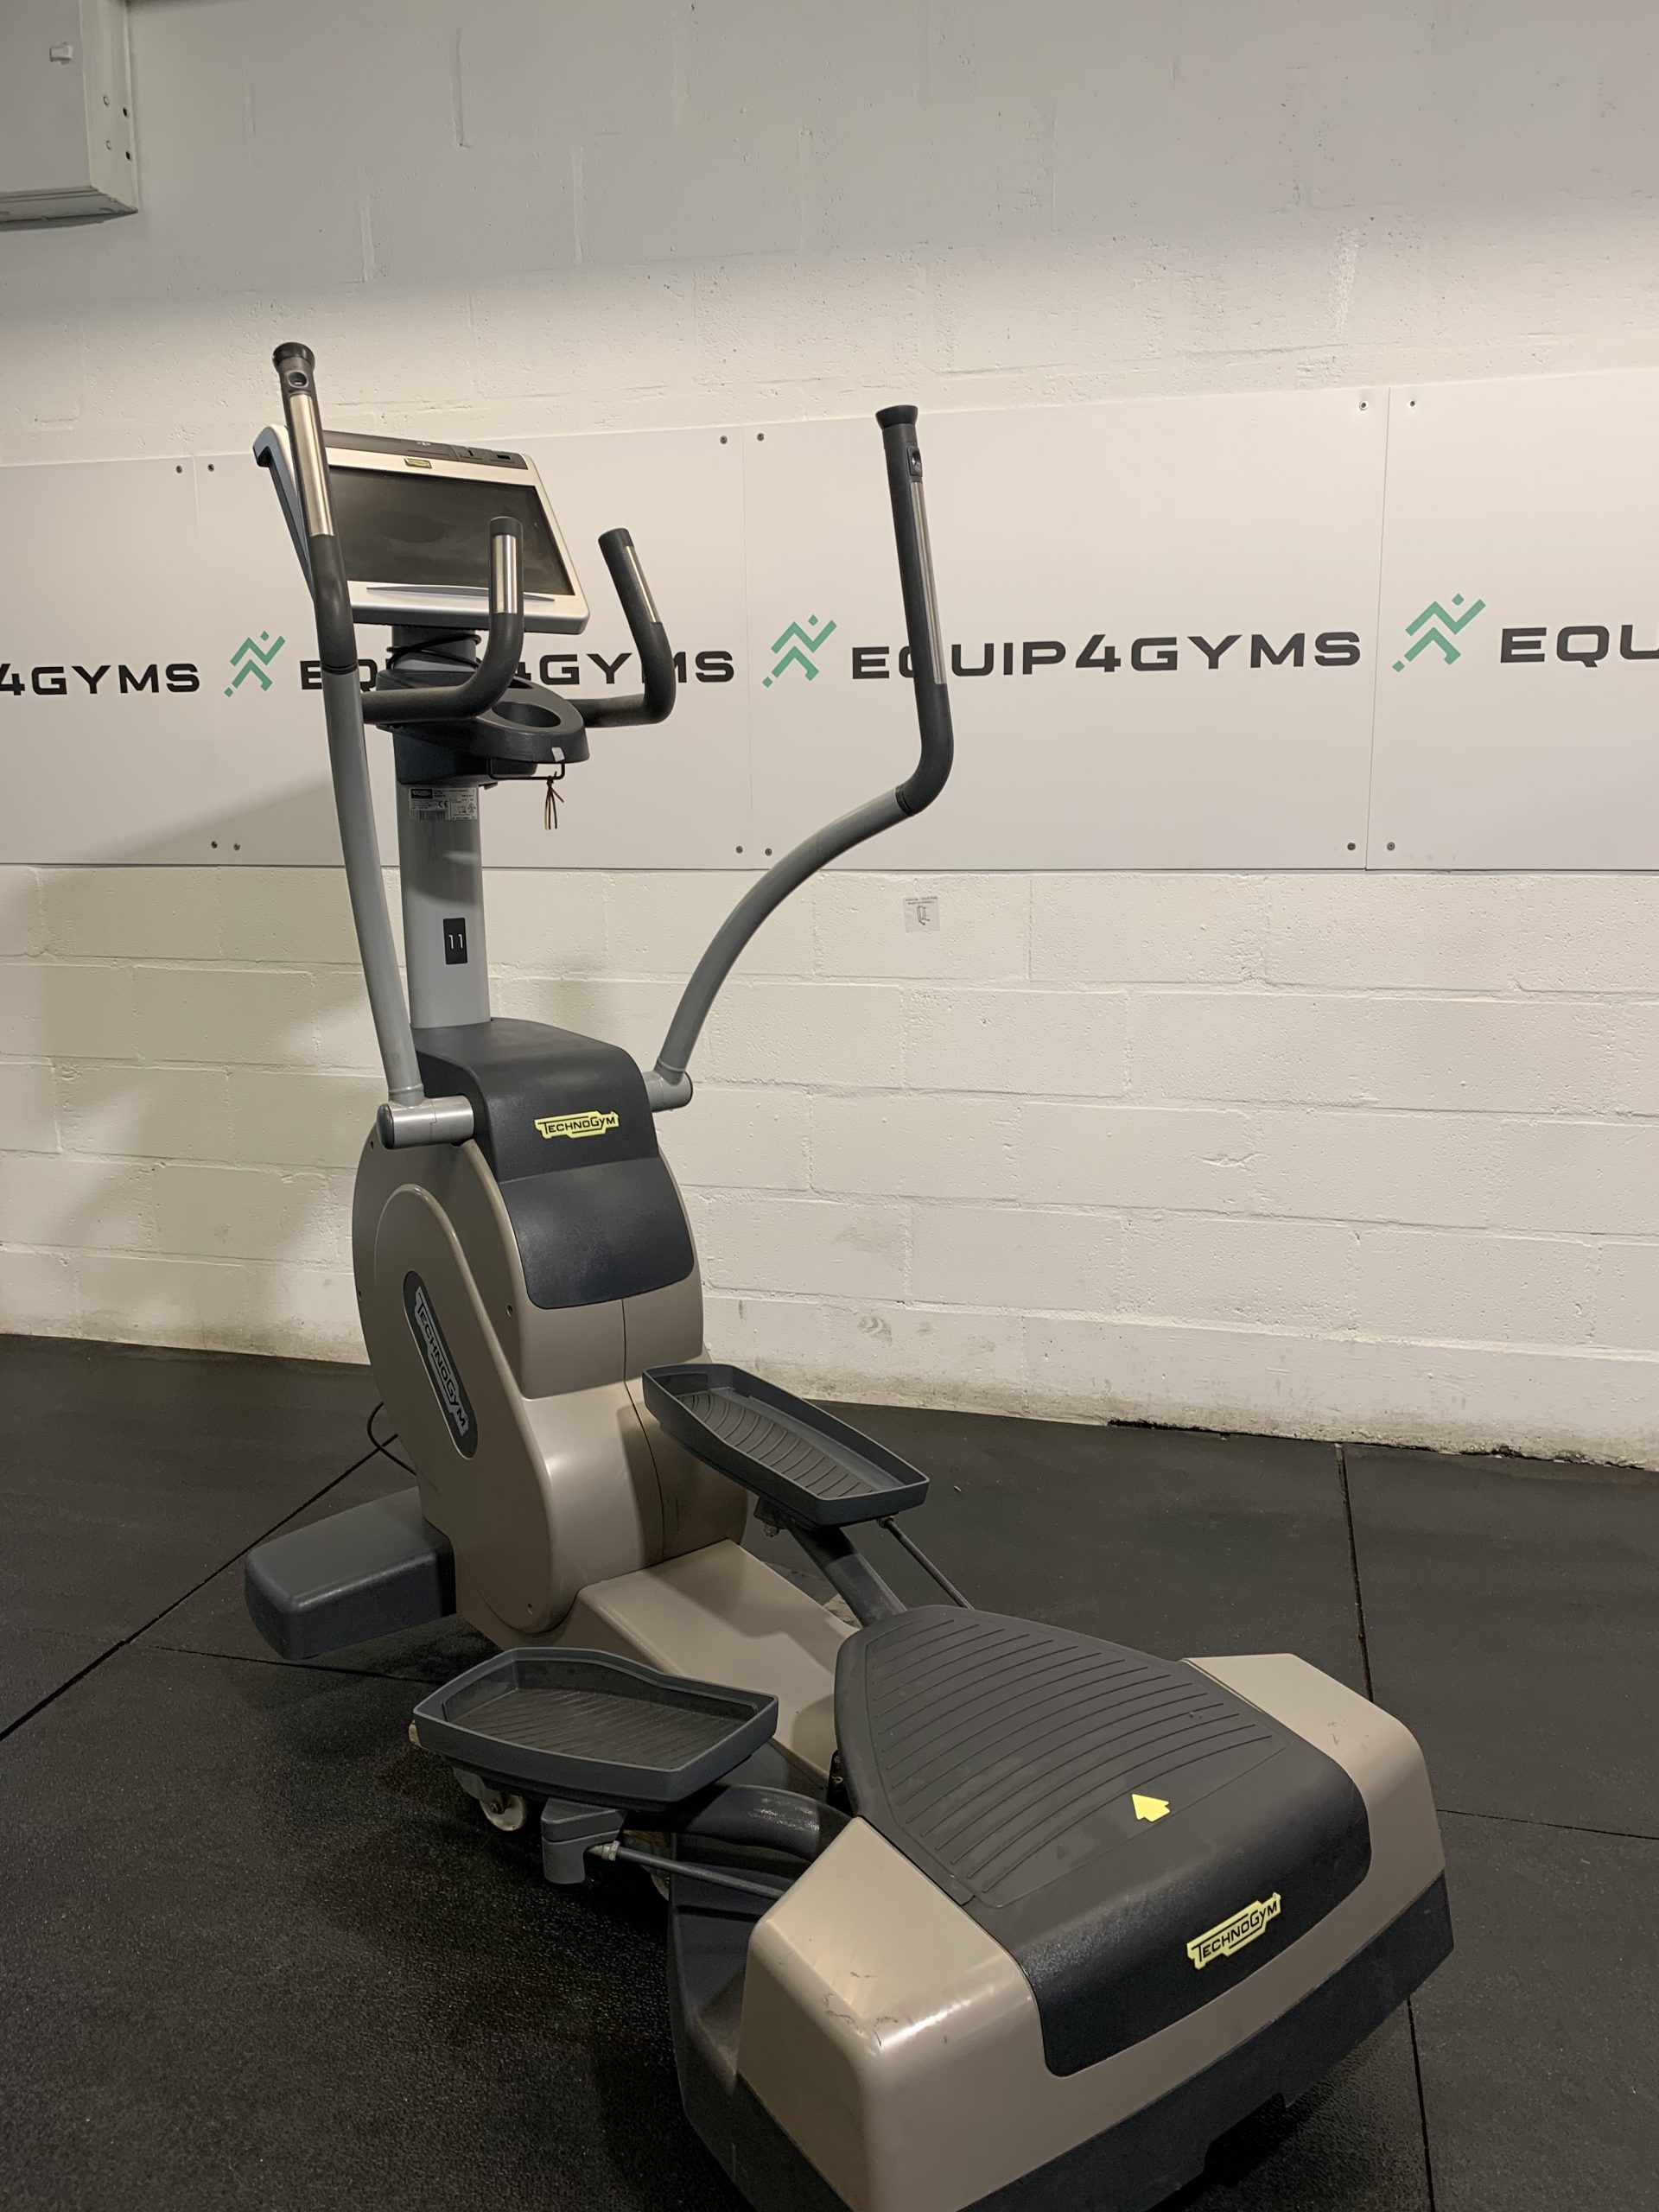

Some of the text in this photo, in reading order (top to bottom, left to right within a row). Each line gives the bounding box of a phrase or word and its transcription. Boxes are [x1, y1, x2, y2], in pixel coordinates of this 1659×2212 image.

[1500, 624, 1659, 668] EQU
[448, 933, 463, 950] 11
[537, 1115, 616, 1135] TECHNOGYM
[417, 1292, 466, 1427] TECHNOGYM
[1191, 1900, 1279, 1963] TECHNOGYM
